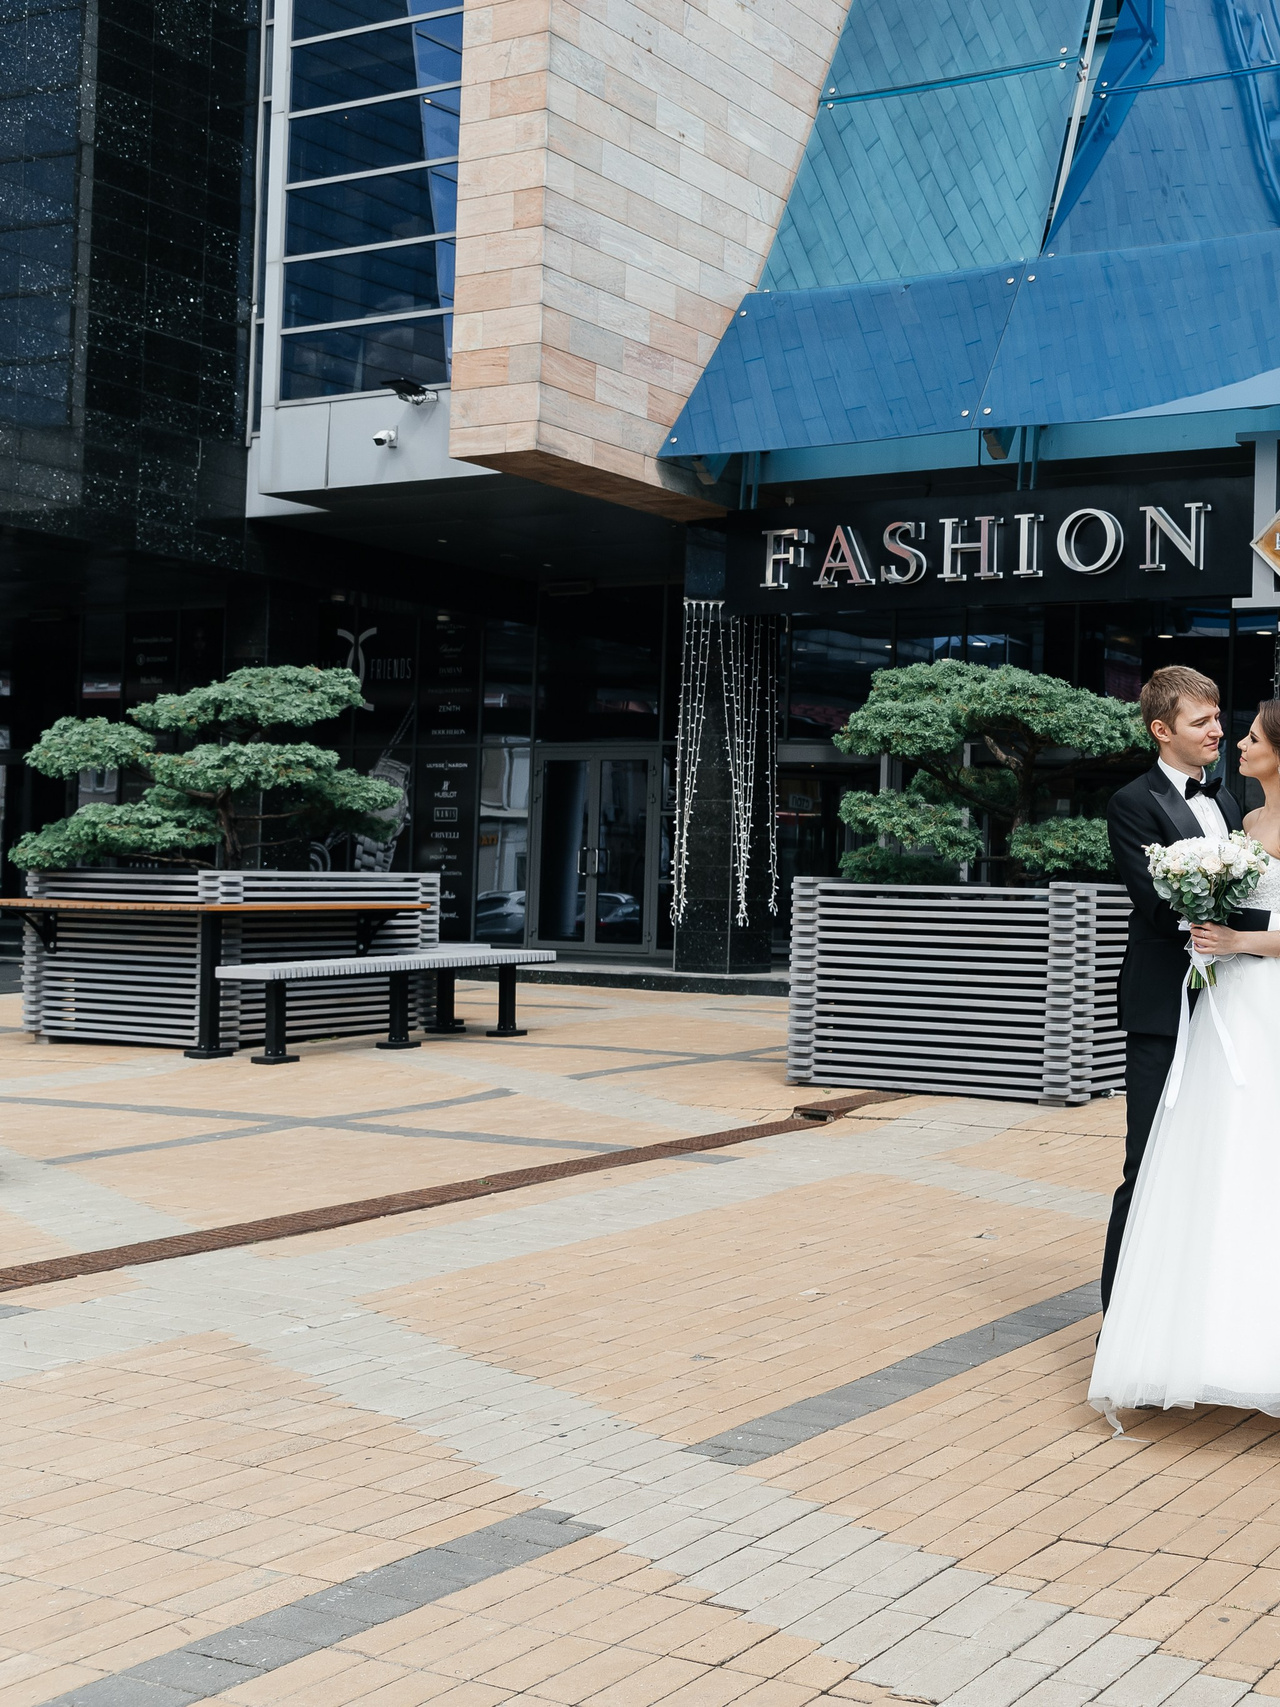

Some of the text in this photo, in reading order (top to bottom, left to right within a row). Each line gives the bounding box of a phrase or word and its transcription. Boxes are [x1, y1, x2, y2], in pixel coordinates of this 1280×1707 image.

[759, 502, 1213, 590] FASHION
[370, 657, 413, 680] FRIENDS
[438, 704, 461, 713] ZENITH
[430, 831, 460, 839] CRIVELLI
